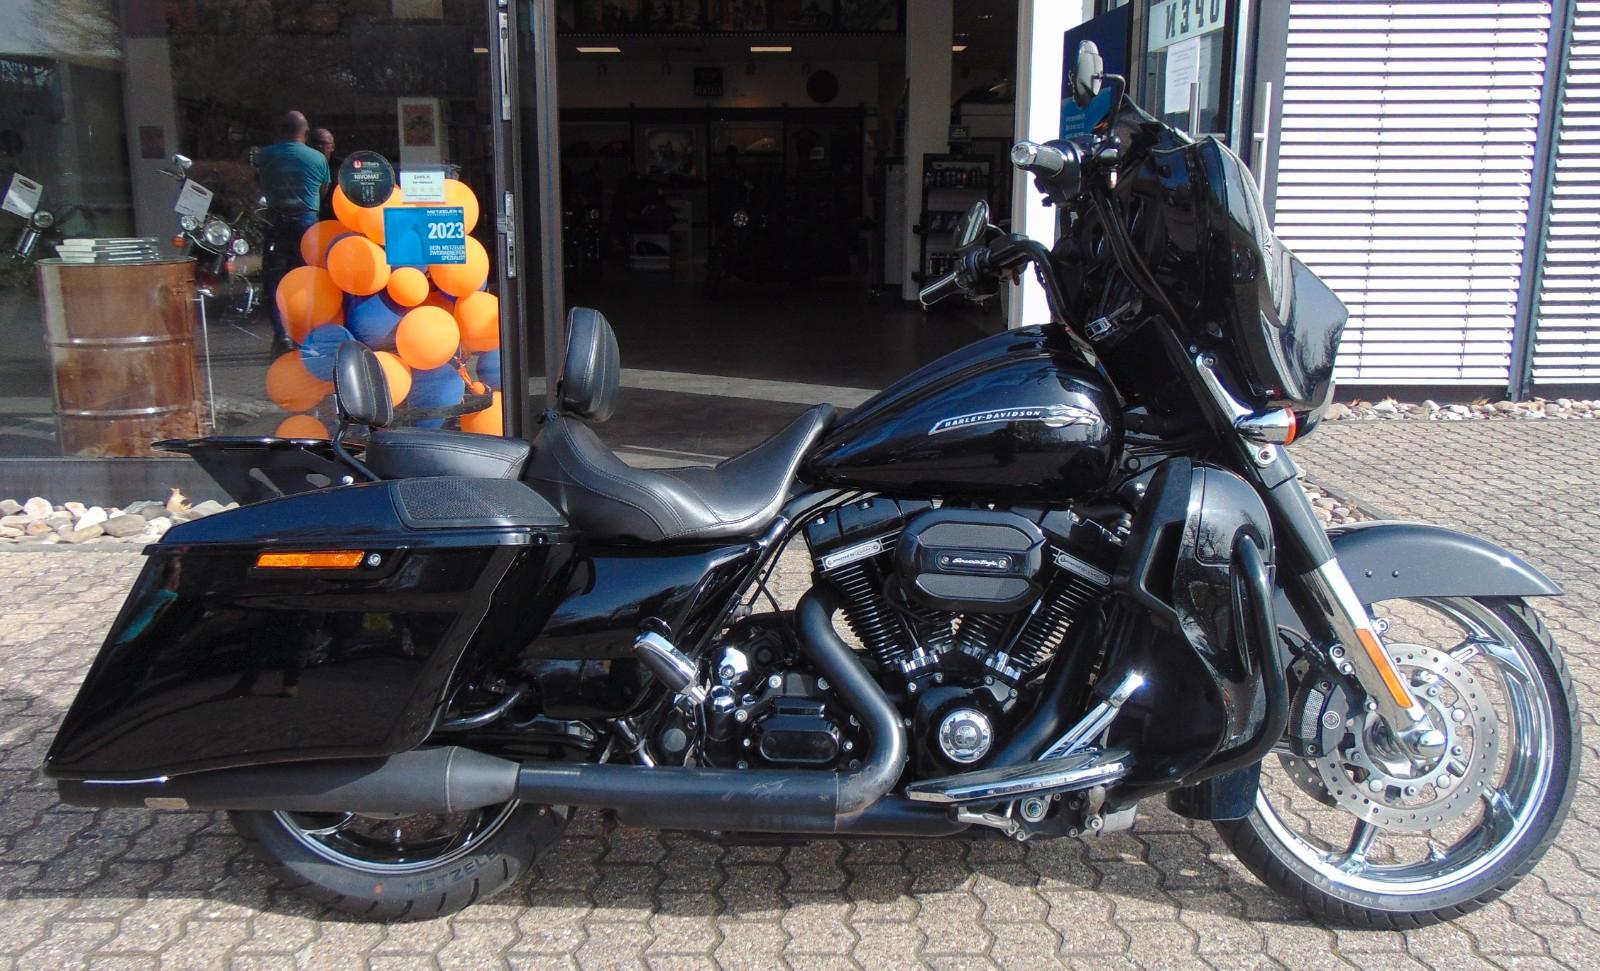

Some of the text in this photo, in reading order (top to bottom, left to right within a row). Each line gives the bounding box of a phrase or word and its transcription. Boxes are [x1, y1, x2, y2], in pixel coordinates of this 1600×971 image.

[428, 222, 465, 239] 2023
[944, 410, 1041, 428] HARLEY-DAVIDSON
[406, 846, 500, 893] METZELE
